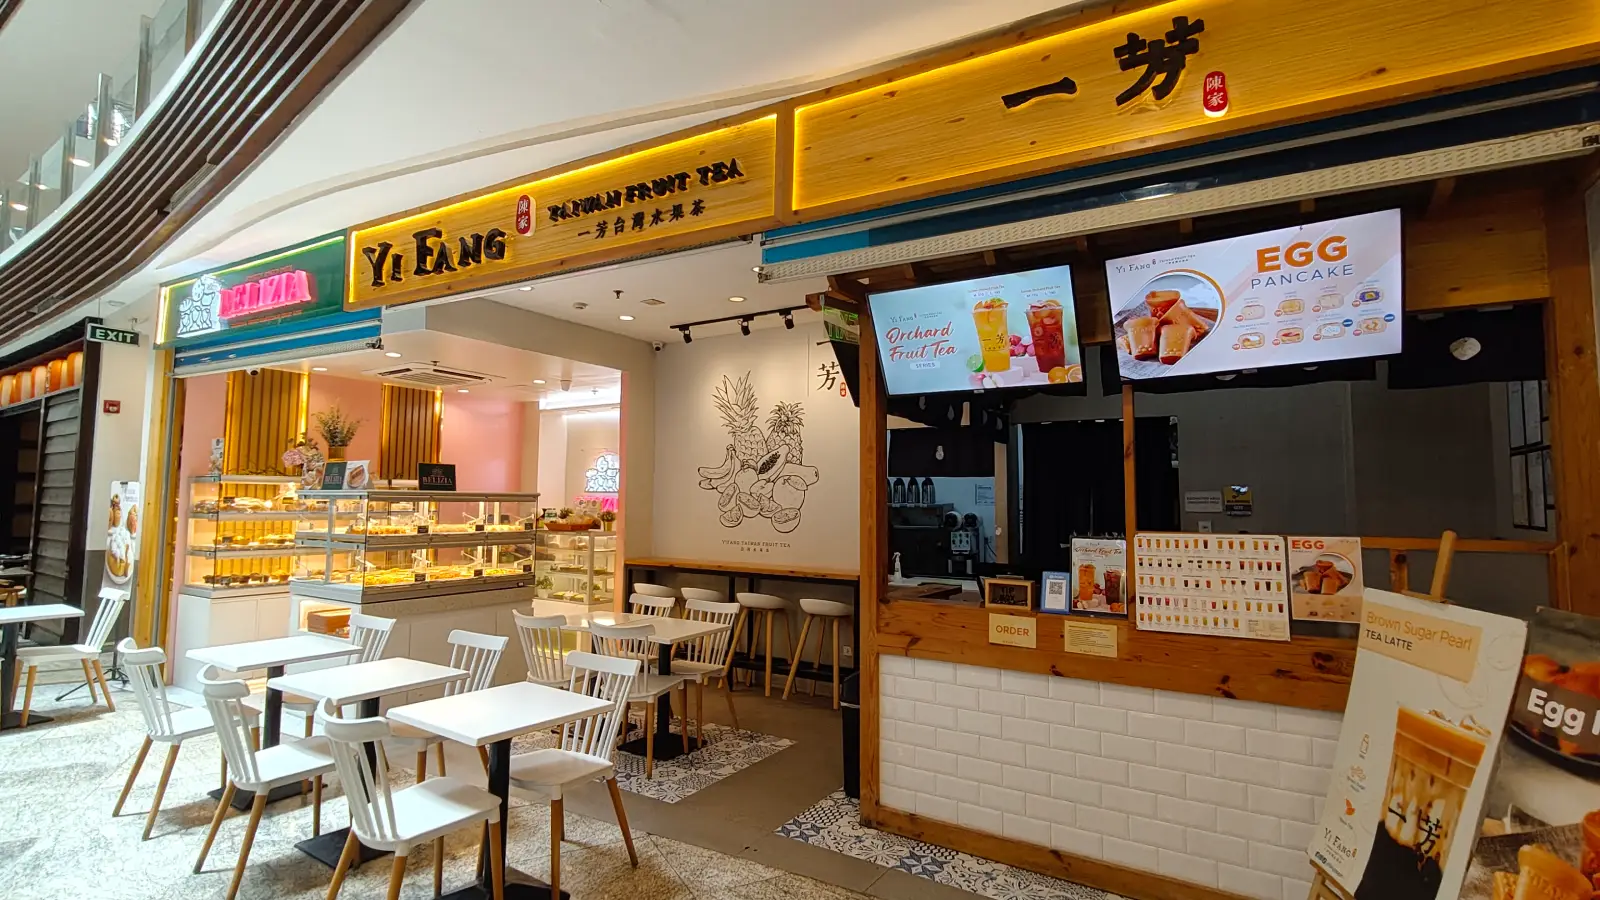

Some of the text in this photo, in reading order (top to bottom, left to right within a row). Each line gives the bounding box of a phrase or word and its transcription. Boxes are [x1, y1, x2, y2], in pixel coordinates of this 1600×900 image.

[1001, 16, 1204, 108] 一芳
[1206, 75, 1225, 107] 陳家
[547, 158, 744, 222] TAIWAN FRUIT TEA
[517, 199, 529, 230] 陳家
[578, 199, 706, 239] 一芳台灣水果茶
[412, 227, 507, 276] FANG
[1256, 235, 1348, 273] EGG
[1251, 264, 1354, 289] PANCAKE
[96, 328, 134, 343] EXIT
[886, 321, 954, 344] Orchard
[889, 340, 957, 362] Fruit Tea
[1291, 540, 1324, 550] EGG
[995, 625, 1030, 637] ORDER
[1366, 629, 1413, 651] TEA LATTE
[1367, 611, 1473, 651] Brown Sugar Pearl
[1527, 687, 1585, 736] Egg
[1388, 807, 1443, 855] 一芳
